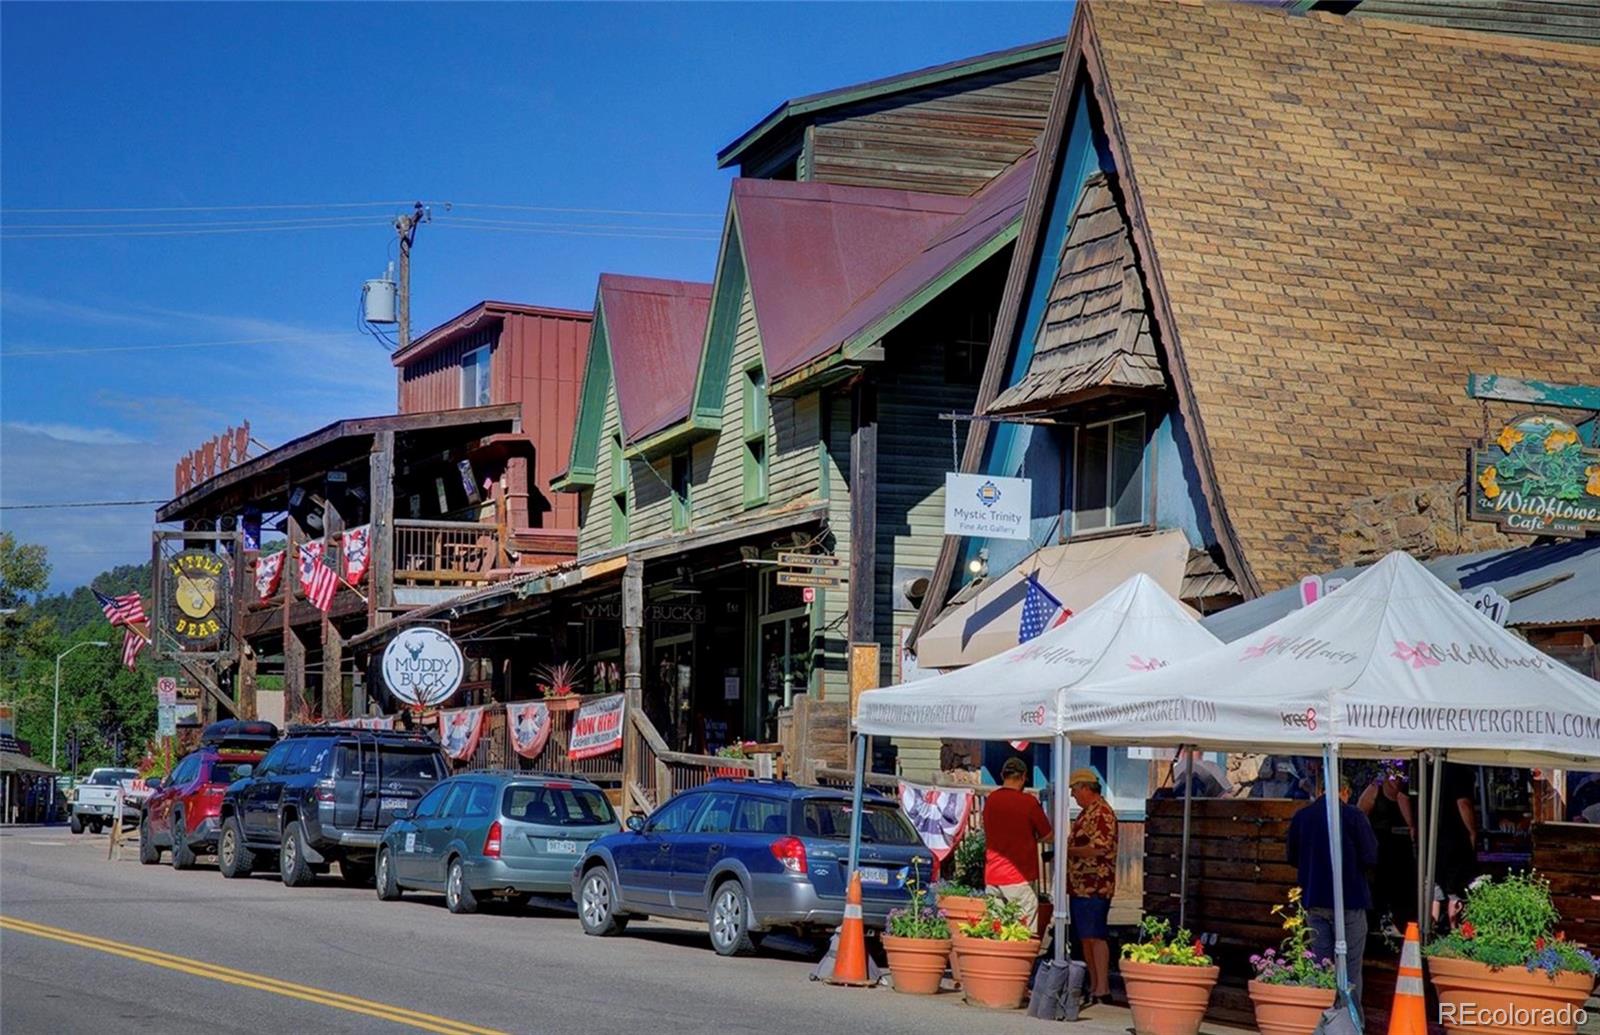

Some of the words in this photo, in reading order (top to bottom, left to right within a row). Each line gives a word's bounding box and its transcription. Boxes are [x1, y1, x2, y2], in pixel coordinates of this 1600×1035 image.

[1494, 489, 1600, 521] Wildflowe
[953, 507, 987, 522] Mystic
[989, 510, 1022, 525] Trinity
[1507, 513, 1545, 531] Cafe
[959, 522, 974, 531] Fine
[976, 523, 989, 532] Art
[989, 524, 1017, 535] Gallery
[168, 555, 223, 577] LITTLE
[652, 606, 695, 621] BUCK
[175, 619, 220, 637] BEAR
[395, 657, 453, 673] MUDDY
[400, 672, 446, 687] BUCK
[575, 715, 596, 737] NOW
[1345, 703, 1600, 739] WILDFLOWEREVERGREEN.COM
